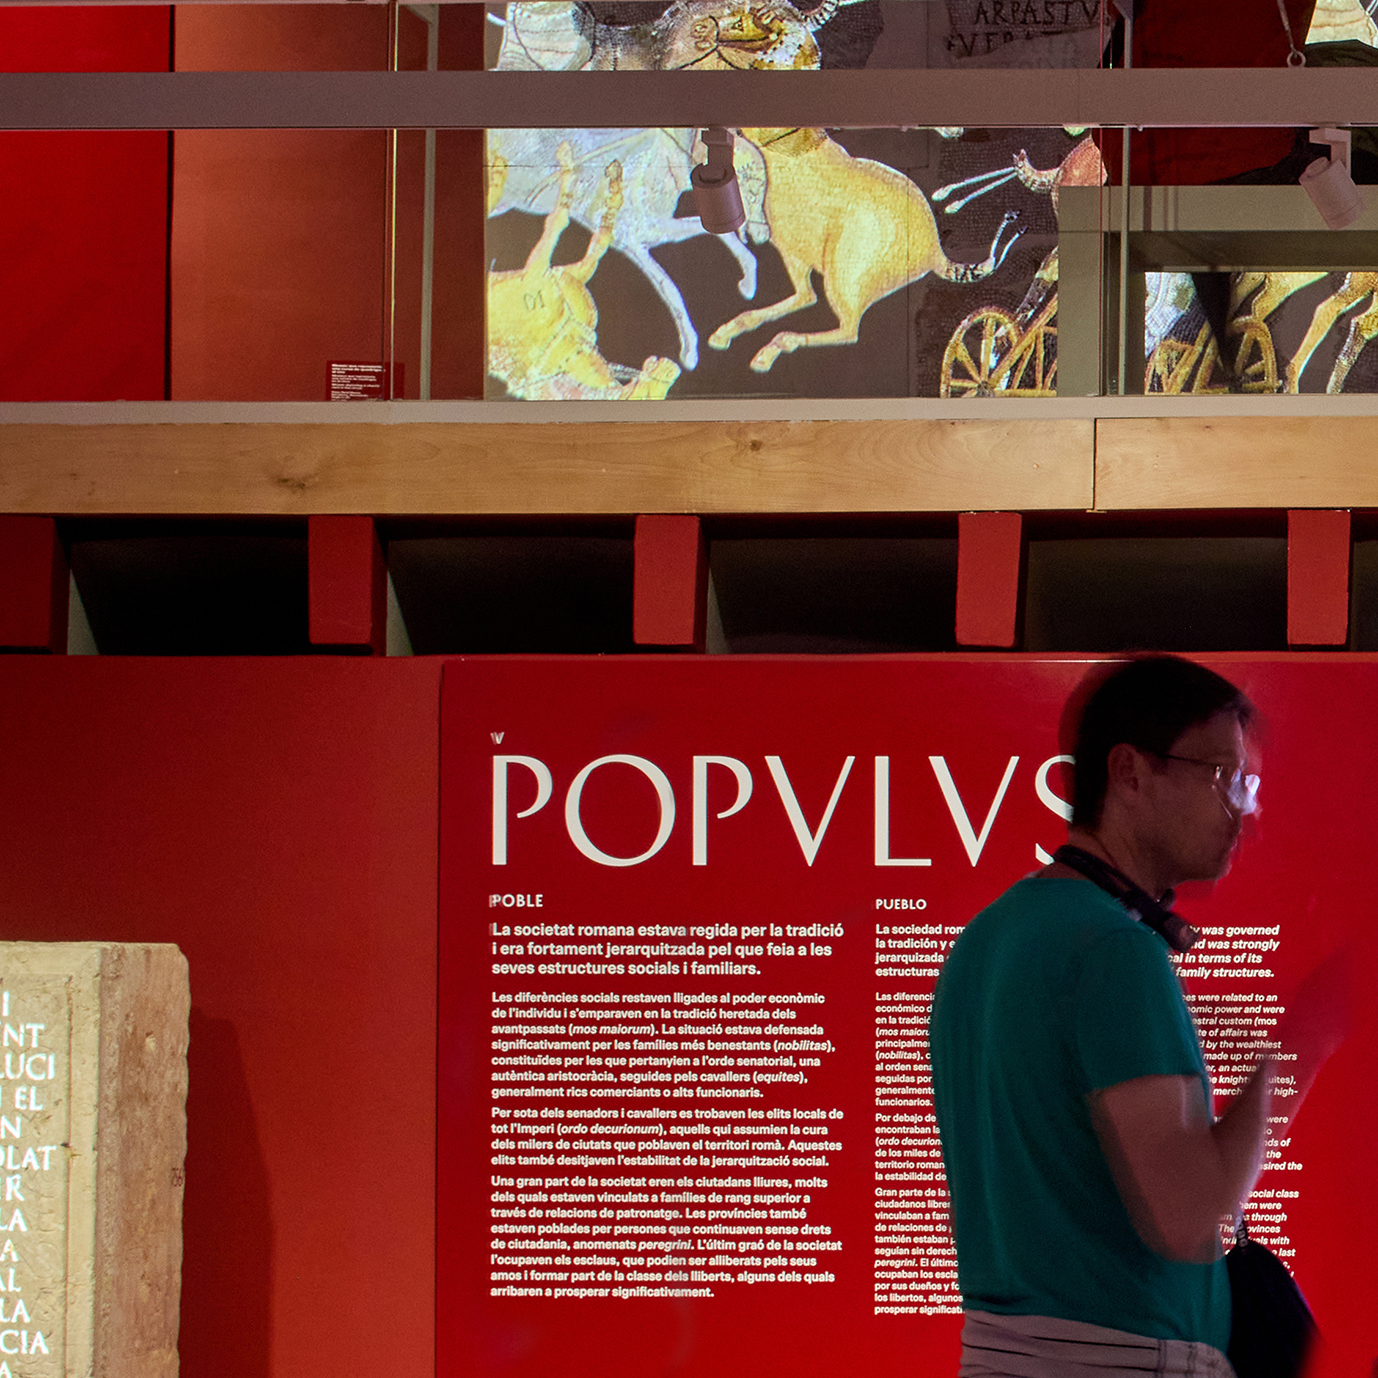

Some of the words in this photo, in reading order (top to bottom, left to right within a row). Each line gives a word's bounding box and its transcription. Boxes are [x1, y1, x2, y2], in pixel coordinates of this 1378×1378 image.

[489, 893, 544, 909] POBLE
[874, 898, 928, 910] PUEBLO
[490, 922, 510, 936] La
[514, 923, 574, 936] societat
[578, 926, 634, 936] romana
[638, 924, 686, 936] estava
[690, 923, 738, 940] regida
[742, 926, 767, 939] per
[770, 923, 783, 936] la
[786, 923, 844, 937] tradició
[876, 924, 890, 934] La
[892, 924, 942, 934] sociedad
[1202, 927, 1224, 935] was
[1226, 925, 1280, 937] governed
[492, 942, 496, 954] i
[500, 945, 524, 955] era
[527, 942, 603, 955] fortament
[605, 942, 705, 958] jerarquitzada
[708, 942, 731, 958] pel
[735, 946, 764, 958] que
[766, 942, 794, 956] feia
[798, 946, 807, 956] a
[810, 942, 832, 956] les
[876, 938, 886, 948] la
[888, 938, 938, 948] tradición
[940, 940, 947, 950] y
[1208, 941, 1230, 949] was
[1232, 939, 1280, 952] strongly
[875, 950, 944, 964] jerarquizada
[1185, 953, 1196, 963] in
[1198, 954, 1232, 963] terms
[1233, 953, 1246, 963] of
[1246, 953, 1262, 963] its
[492, 964, 535, 974] seves
[538, 962, 625, 974] estructures
[628, 961, 680, 974] socials
[684, 962, 687, 974] i
[690, 961, 761, 974] familiars.
[876, 967, 940, 976] estructuras
[1176, 966, 1211, 979] family
[1212, 968, 1274, 977] structures.
[0, 1022, 45, 1048] NT
[0, 1052, 56, 1080] UCI
[14, 1085, 43, 1111] EL
